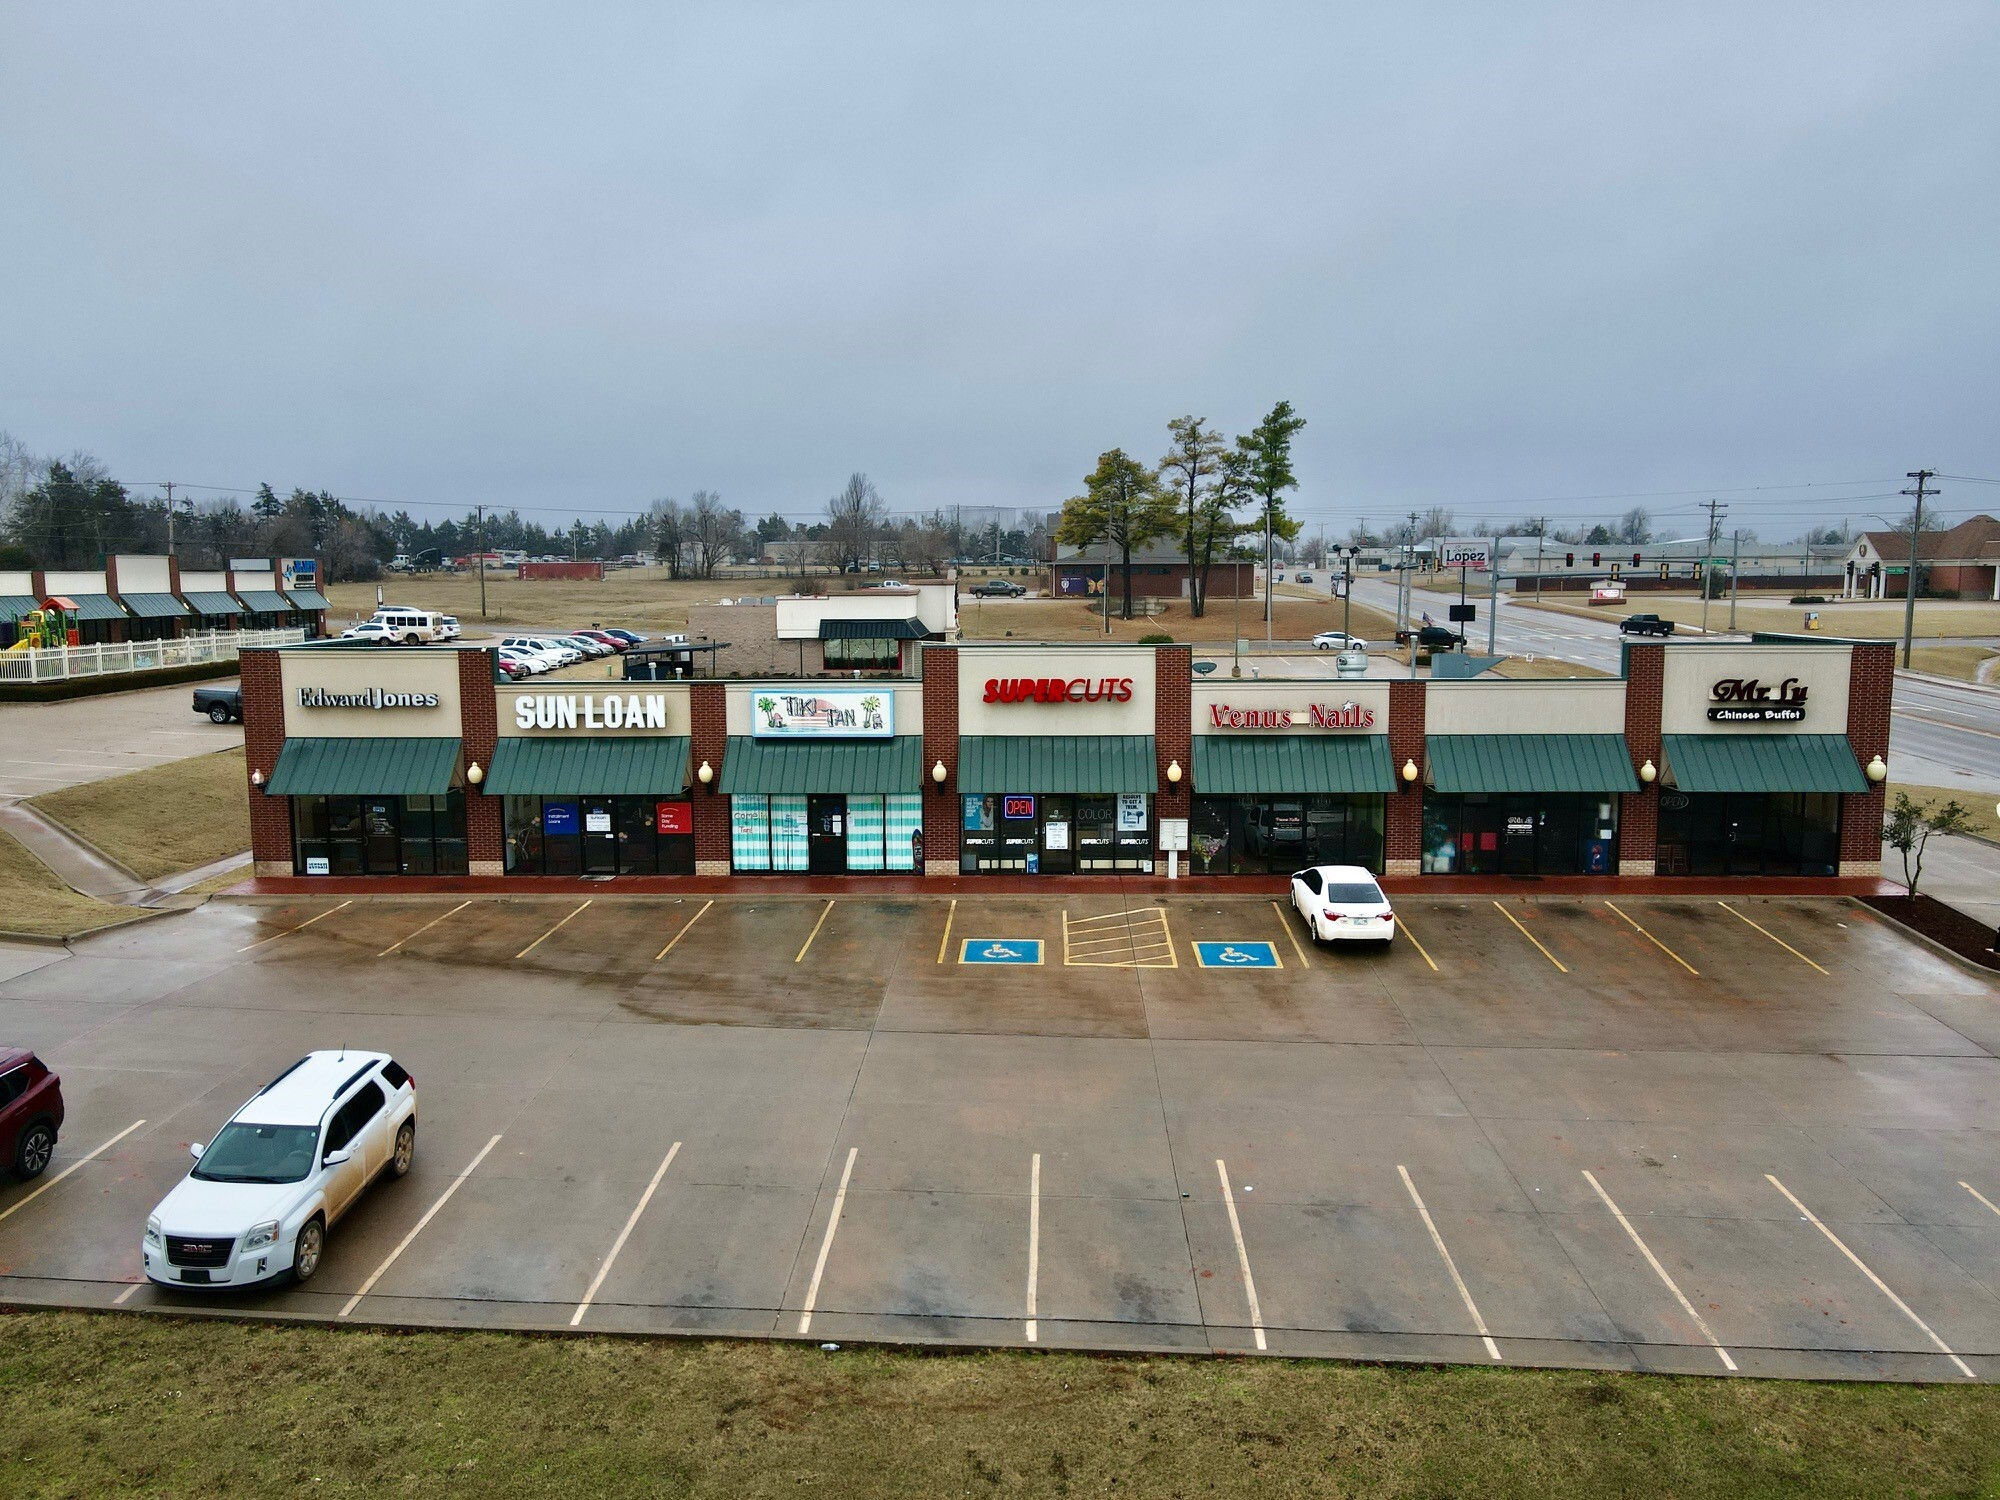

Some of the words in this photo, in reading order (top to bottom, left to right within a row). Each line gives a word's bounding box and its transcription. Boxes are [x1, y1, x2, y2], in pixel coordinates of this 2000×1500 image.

[1446, 550, 1485, 564] Lopez
[983, 678, 1133, 703] SUPERCUTS
[1713, 679, 1771, 702] Mr.
[1775, 678, 1808, 706] Lu
[515, 695, 577, 729] SUN
[585, 694, 667, 729] LOAN
[780, 696, 816, 717] TIKI
[1210, 704, 1292, 728] Venus
[1309, 702, 1375, 728] Nails
[1717, 710, 1760, 720] Chinese
[1765, 710, 1801, 720] Buffet
[822, 709, 857, 728] TAN
[1006, 801, 1032, 814] OPEN
[1078, 808, 1112, 820] COLOR
